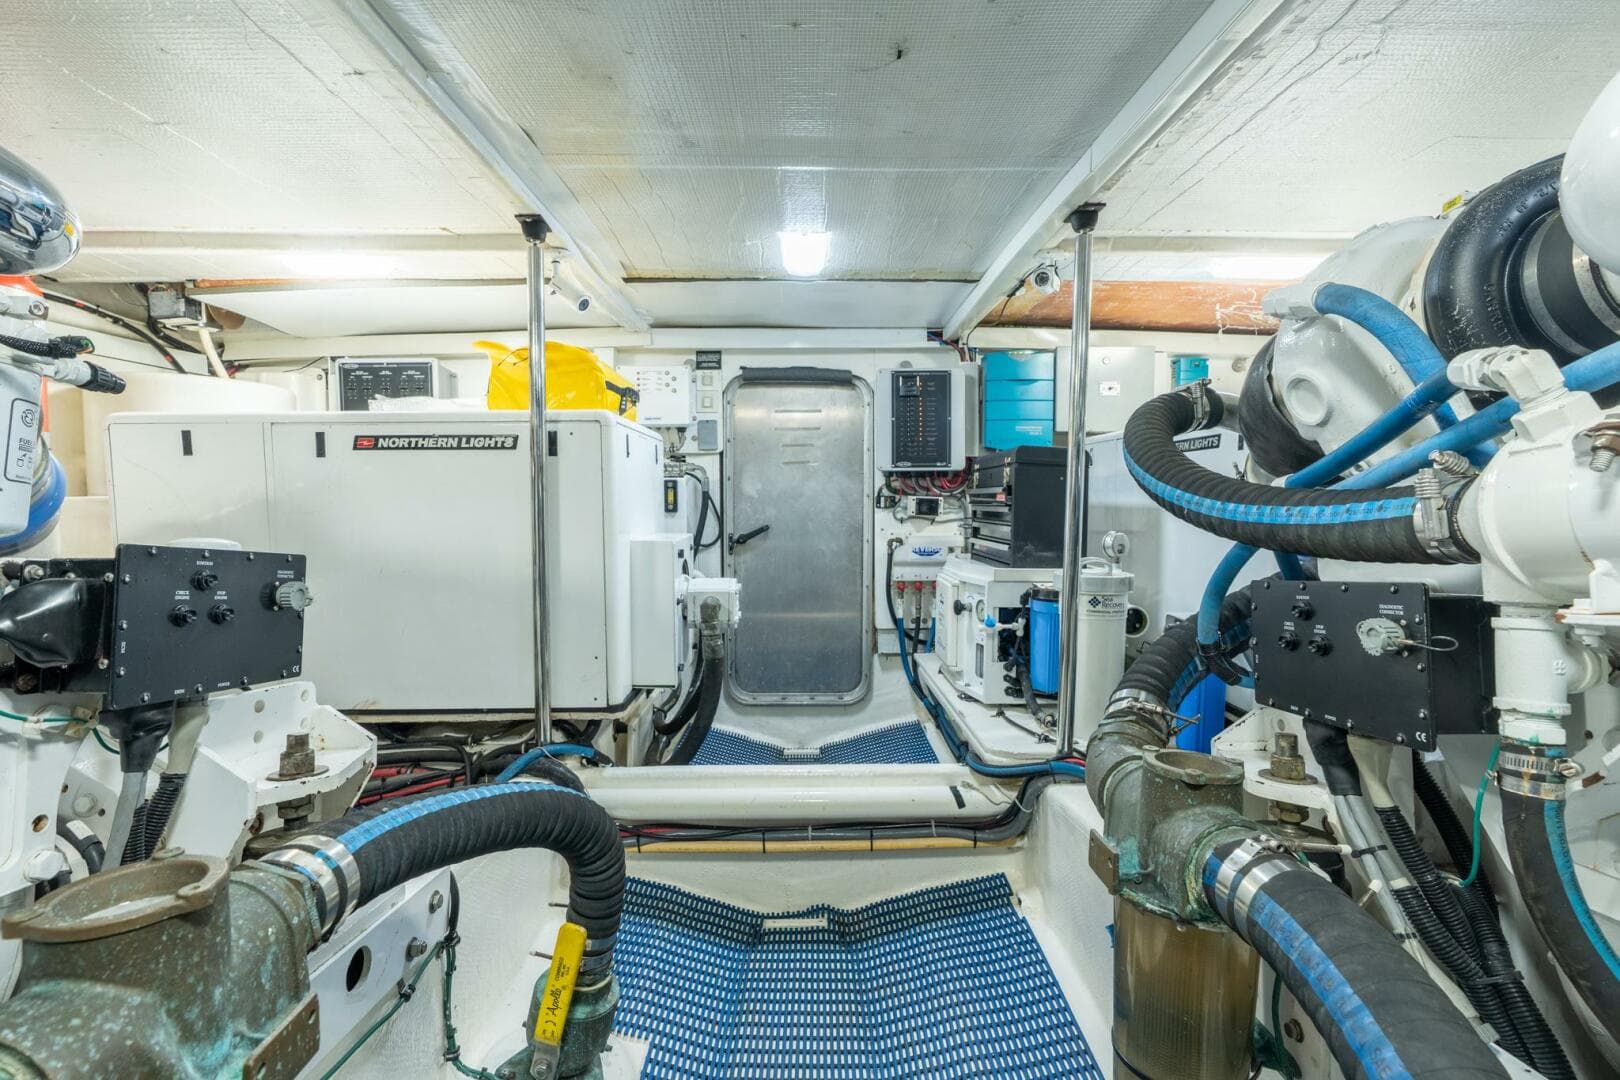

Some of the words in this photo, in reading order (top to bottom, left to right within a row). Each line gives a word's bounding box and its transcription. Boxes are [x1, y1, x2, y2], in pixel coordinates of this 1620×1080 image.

[378, 437, 458, 448] NORTHERN
[461, 437, 514, 448] LIGHTS
[1190, 436, 1220, 449] LIGHTS
[1415, 731, 1427, 743] CE
